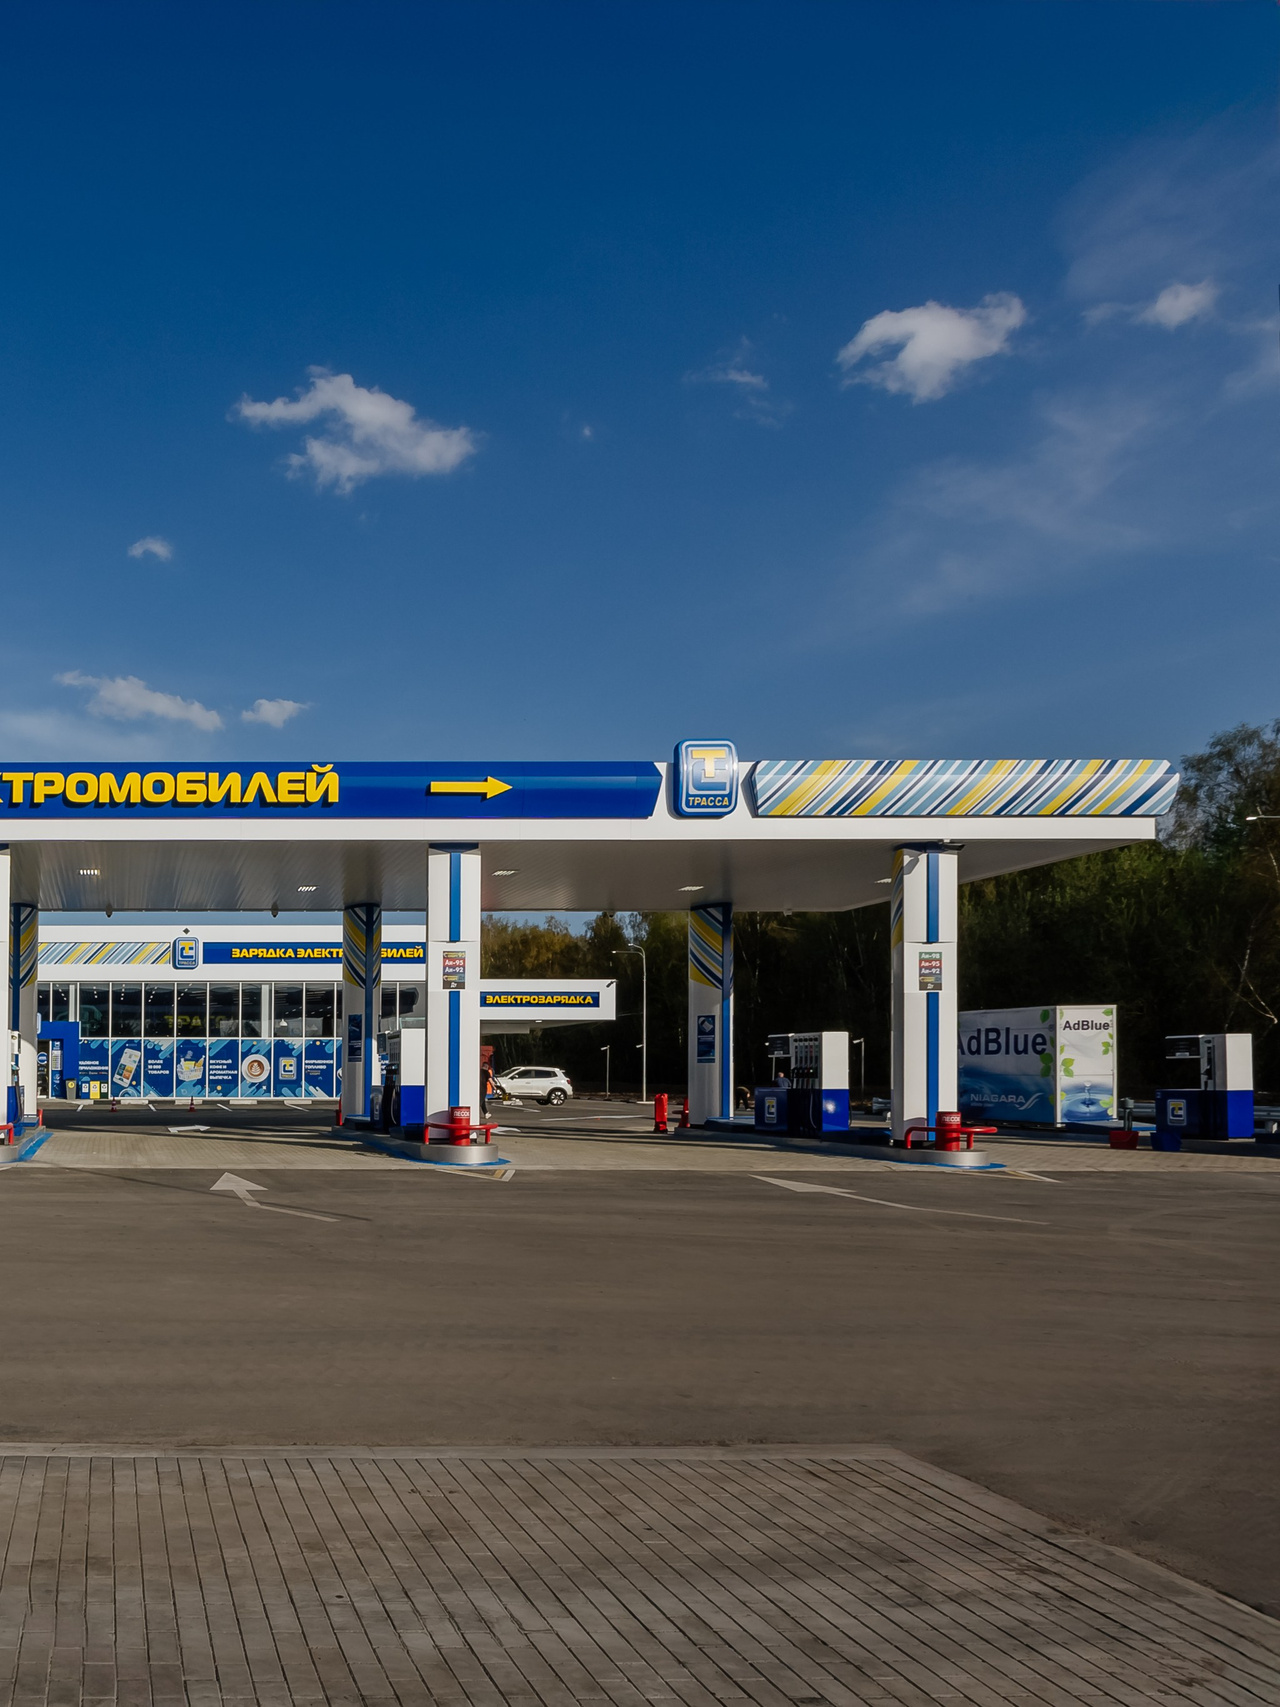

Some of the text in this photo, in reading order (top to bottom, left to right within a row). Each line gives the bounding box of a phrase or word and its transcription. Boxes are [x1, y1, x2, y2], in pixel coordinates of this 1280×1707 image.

[688, 797, 729, 806] ТРАССА
[231, 946, 424, 958] ЗАРЯДКА ЭЛЕКТБИЛЕЙ
[485, 995, 593, 1004] ЭЛЕКТРОЗАРЯДКА
[1062, 1020, 1110, 1031] AdBlue
[970, 1093, 1026, 1103] NIAGARA
